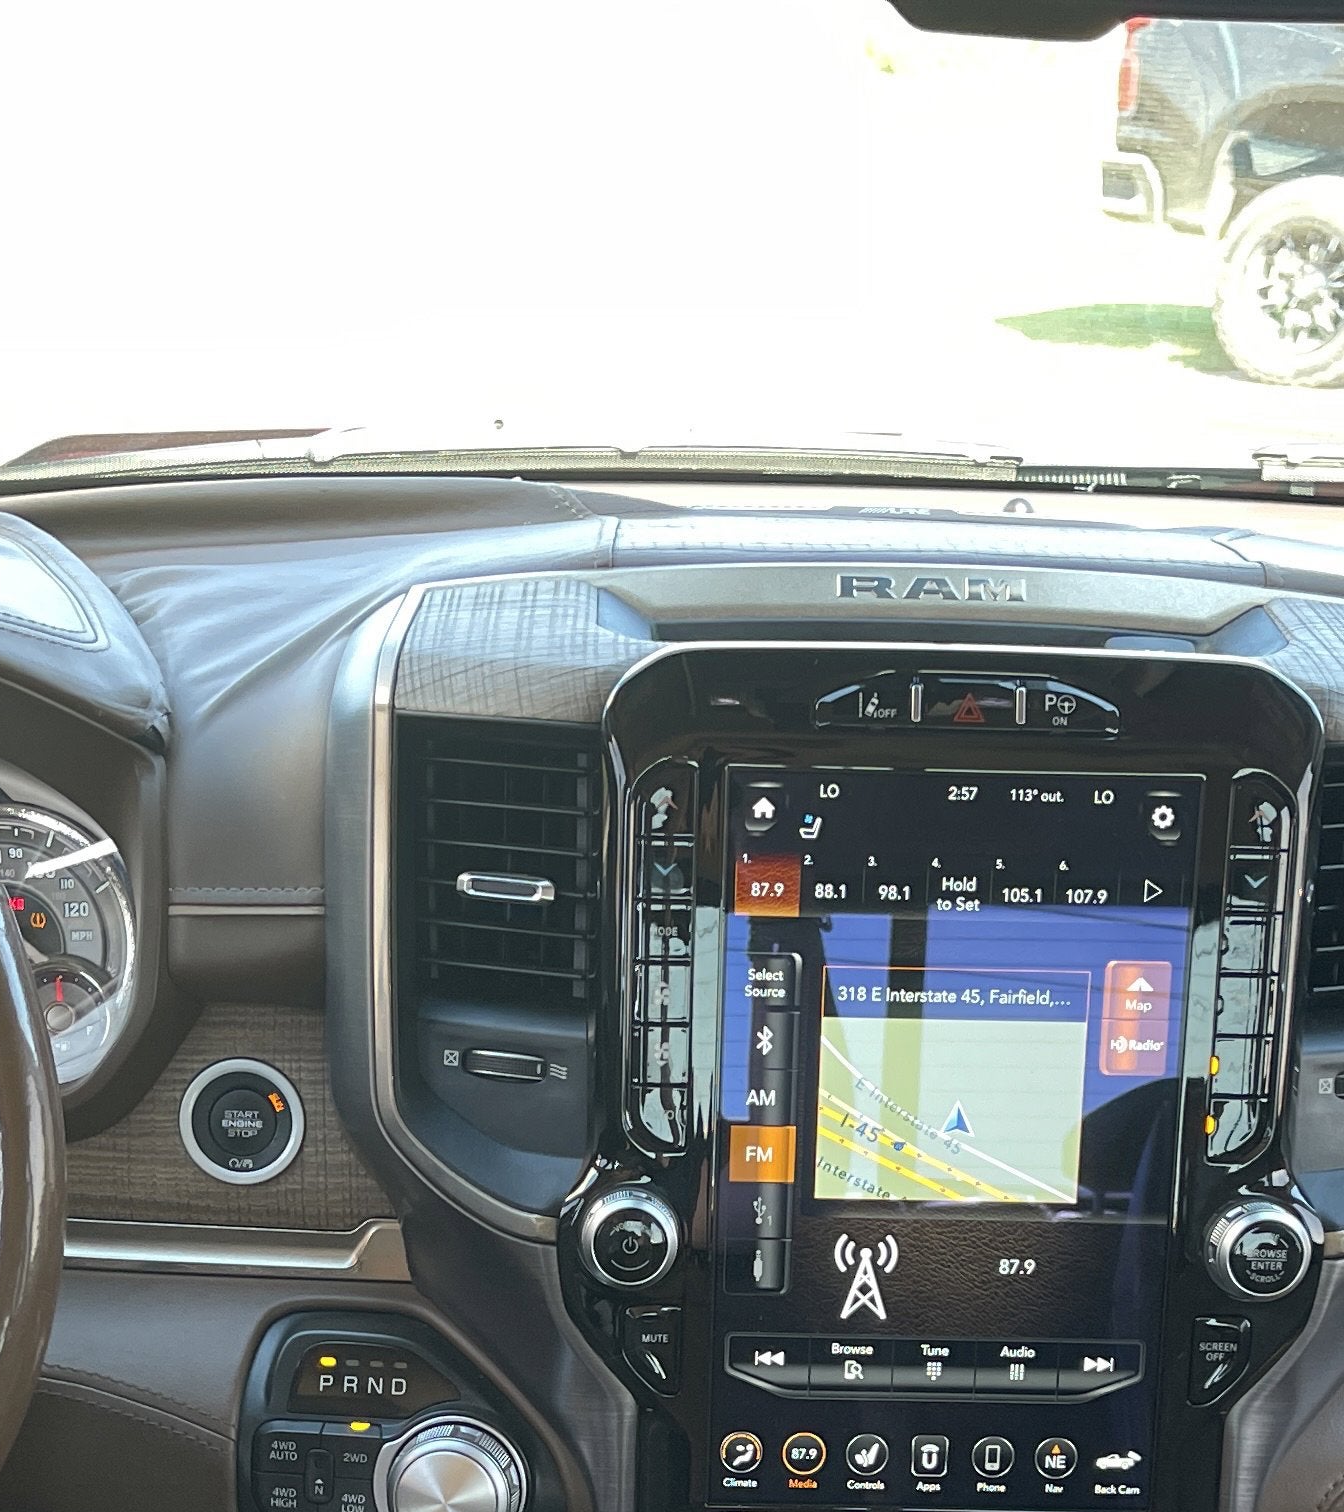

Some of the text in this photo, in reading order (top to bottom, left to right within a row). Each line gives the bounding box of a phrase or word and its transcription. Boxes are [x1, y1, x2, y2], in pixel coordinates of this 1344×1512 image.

[836, 574, 1027, 602] RAM
[878, 708, 897, 719] OFF
[1052, 716, 1068, 726] ON
[819, 783, 840, 799] LO
[947, 786, 978, 801] 2:57
[1040, 791, 1064, 803] out.
[1094, 790, 1114, 804] LO
[8, 848, 23, 859] 90
[742, 854, 752, 864] 1.
[803, 855, 814, 866] 2.
[867, 856, 878, 867] 3.
[931, 858, 942, 869] 4.
[995, 859, 1006, 870] 5.
[1058, 860, 1069, 871] 6.
[59, 878, 75, 890] 110
[750, 882, 784, 897] 87.9
[941, 876, 977, 892] Hold
[814, 884, 847, 899] 88.1
[878, 885, 911, 901] 98.1
[1002, 888, 1043, 903] 105.1
[1065, 889, 1108, 904] 107.9
[63, 902, 89, 918] 120
[936, 897, 980, 912] to Set
[71, 930, 93, 941] MPH
[747, 968, 784, 981] Select
[745, 984, 786, 998] Source
[837, 986, 866, 1002] 318
[872, 987, 881, 1001] E
[886, 987, 957, 1004] Interstate
[961, 989, 984, 1006] 45,
[1125, 1000, 1152, 1013] Map
[745, 1090, 776, 1106] AM
[224, 1110, 259, 1119] START
[222, 1119, 263, 1128] ENGINE
[869, 1088, 938, 1140] Interstate
[943, 1137, 962, 1155] 45
[839, 1112, 880, 1143] I-45
[228, 1129, 257, 1138] STOP
[745, 1147, 773, 1162] FM
[817, 1156, 890, 1200] Interstate
[767, 1215, 773, 1226] 1
[998, 1259, 1036, 1275] 87.9
[1251, 1261, 1283, 1271] ENTER
[1249, 1273, 1281, 1283] SCROLL
[641, 1333, 669, 1344] MUTE
[831, 1343, 874, 1355] Browse
[920, 1344, 949, 1357] Tune
[1000, 1346, 1036, 1358] Audio
[1199, 1341, 1237, 1352] SCREEN
[1206, 1352, 1225, 1361] OFF
[319, 1375, 406, 1395] P R N D
[271, 1440, 297, 1450] 4WD
[269, 1451, 298, 1461] AUTO
[343, 1453, 368, 1463] 2WD
[791, 1447, 818, 1460] 87.9
[1044, 1455, 1067, 1469] NE
[722, 1477, 757, 1488] Climate
[788, 1478, 818, 1489] Media
[847, 1479, 885, 1490] Controls
[916, 1481, 941, 1493] Apps
[976, 1482, 1005, 1493] Phone
[1044, 1483, 1063, 1493] Nav
[272, 1487, 297, 1497] 4WD
[314, 1485, 324, 1495] N
[1094, 1484, 1140, 1495] Back Cam
[270, 1498, 297, 1508] HIGH
[341, 1493, 366, 1504] 4WD
